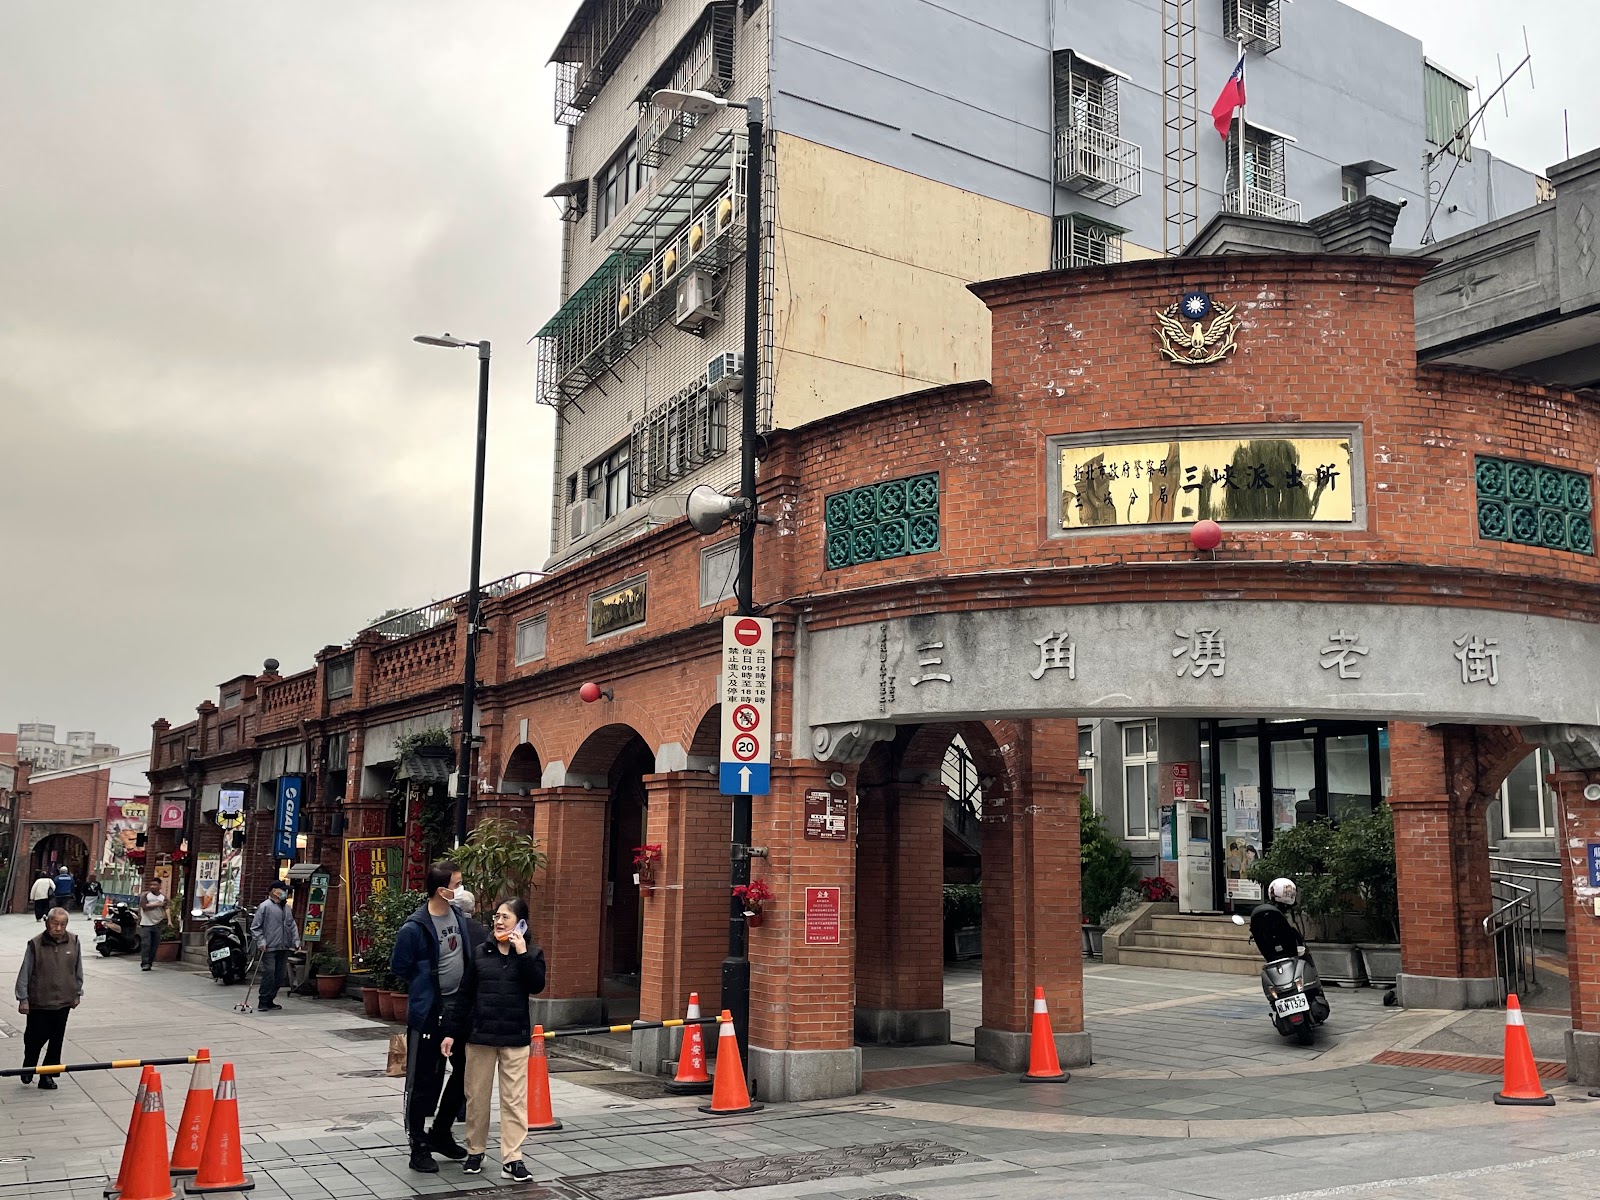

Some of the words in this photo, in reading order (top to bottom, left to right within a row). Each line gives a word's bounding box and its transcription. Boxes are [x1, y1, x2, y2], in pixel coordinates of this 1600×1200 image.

[1182, 463, 1340, 491] 三峽派出所
[727, 647, 739, 703] 禁止進入及停車
[909, 627, 1501, 687] 三角湧老街
[738, 742, 754, 753] 20
[283, 799, 295, 848] GIANT
